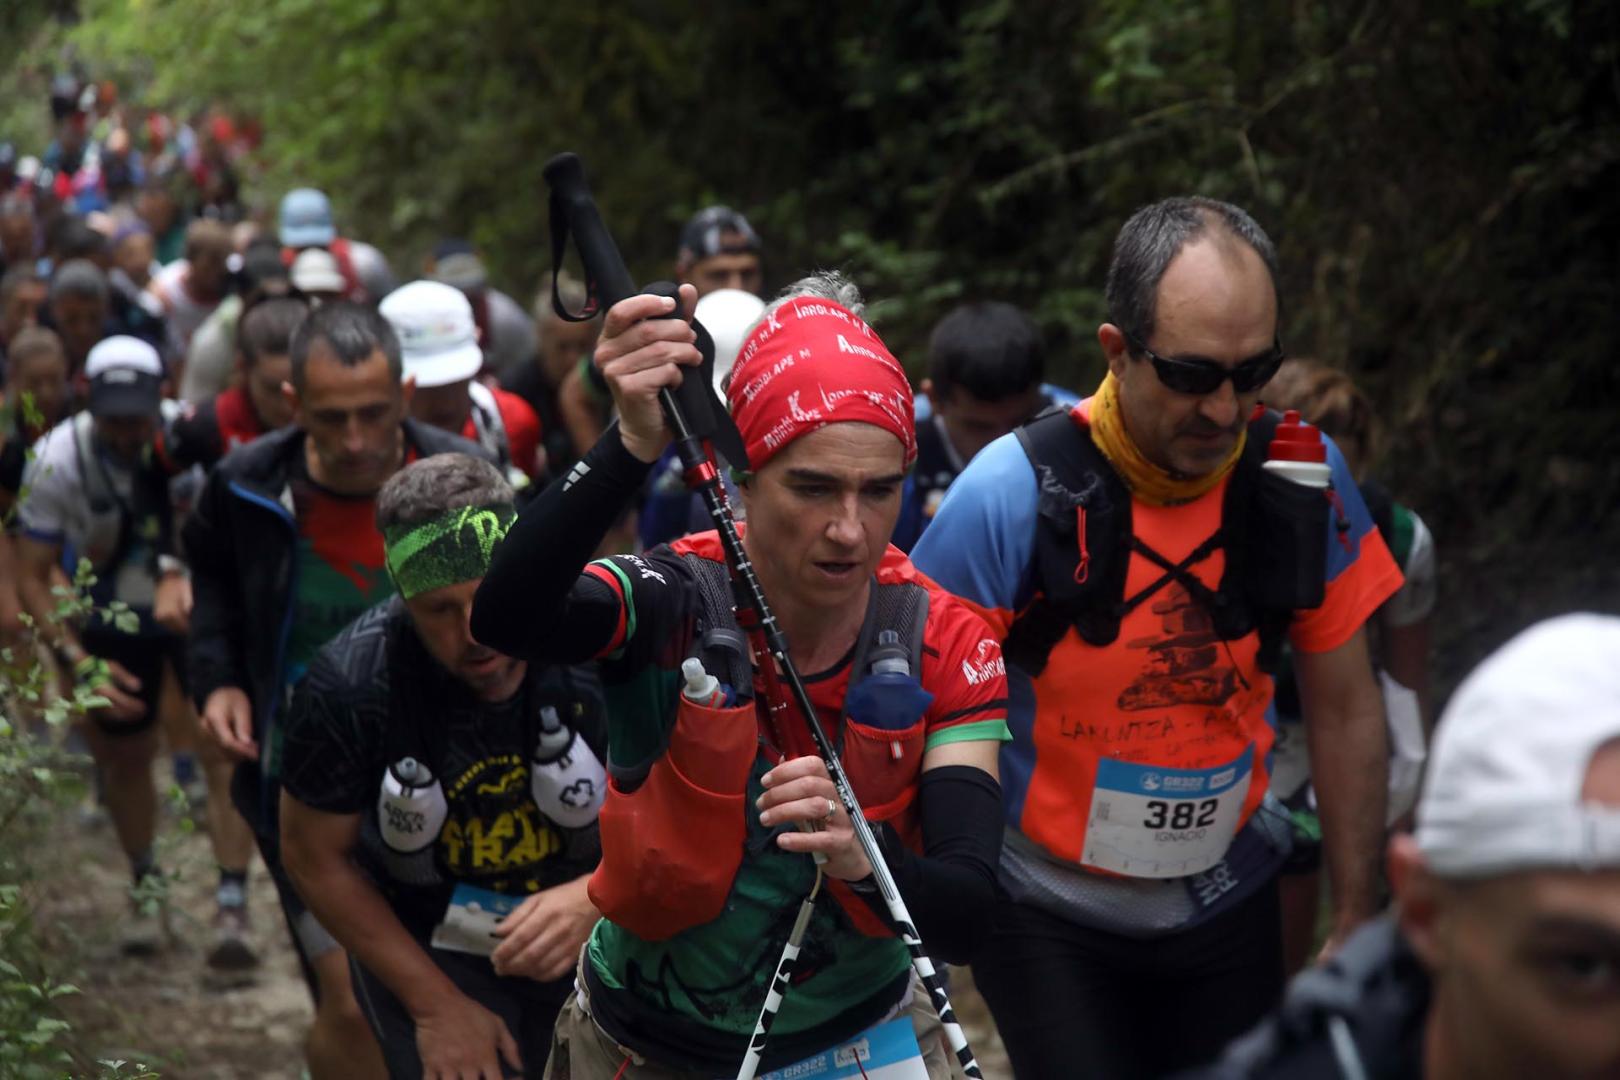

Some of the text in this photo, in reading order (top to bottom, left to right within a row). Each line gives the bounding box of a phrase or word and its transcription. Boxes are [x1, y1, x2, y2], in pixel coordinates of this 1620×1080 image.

[1143, 797, 1219, 831] 382
[1153, 827, 1208, 843] IGNACIO
[783, 1055, 828, 1079] GR322
